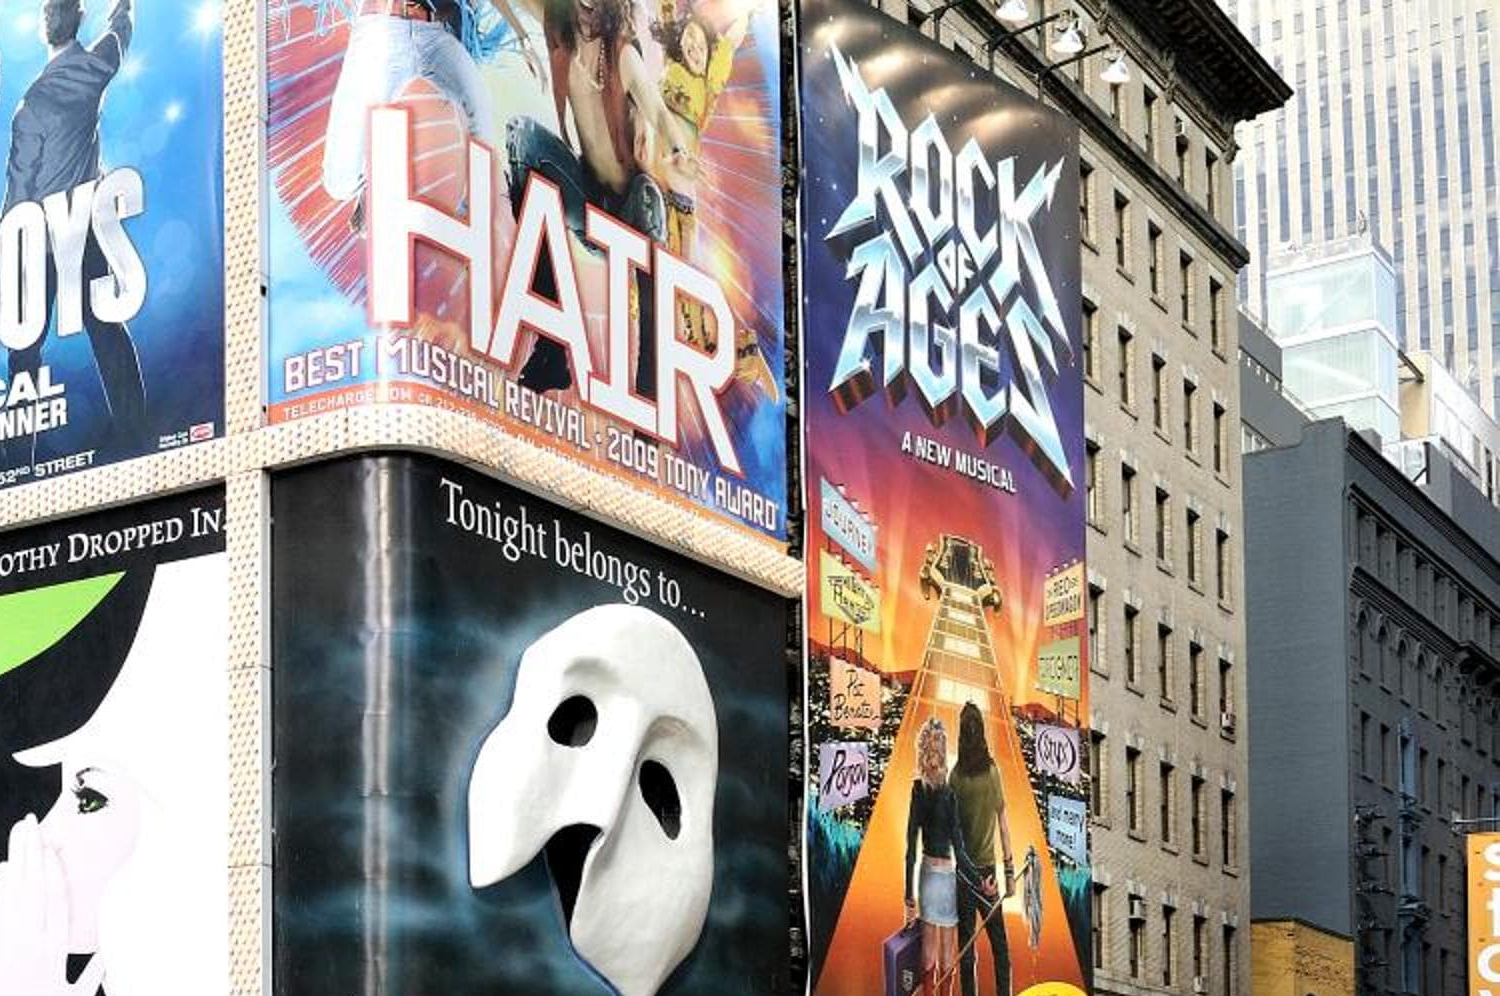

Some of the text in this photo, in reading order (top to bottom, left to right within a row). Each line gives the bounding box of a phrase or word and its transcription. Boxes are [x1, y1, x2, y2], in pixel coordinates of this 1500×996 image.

[824, 37, 1073, 358] ROCK
[937, 239, 975, 293] OF
[369, 105, 746, 477] HAIR
[829, 230, 1075, 490] AGES
[34, 450, 96, 478] STREET
[284, 342, 363, 393] BEST
[374, 329, 500, 409] MUSICAL
[505, 379, 591, 449] REVIVAL
[607, 427, 658, 479] 2009
[665, 453, 709, 501] TONY
[715, 477, 779, 532] AWARD
[902, 431, 1017, 493] A NEW MUSICAL
[440, 477, 650, 605] Tonight belongs
